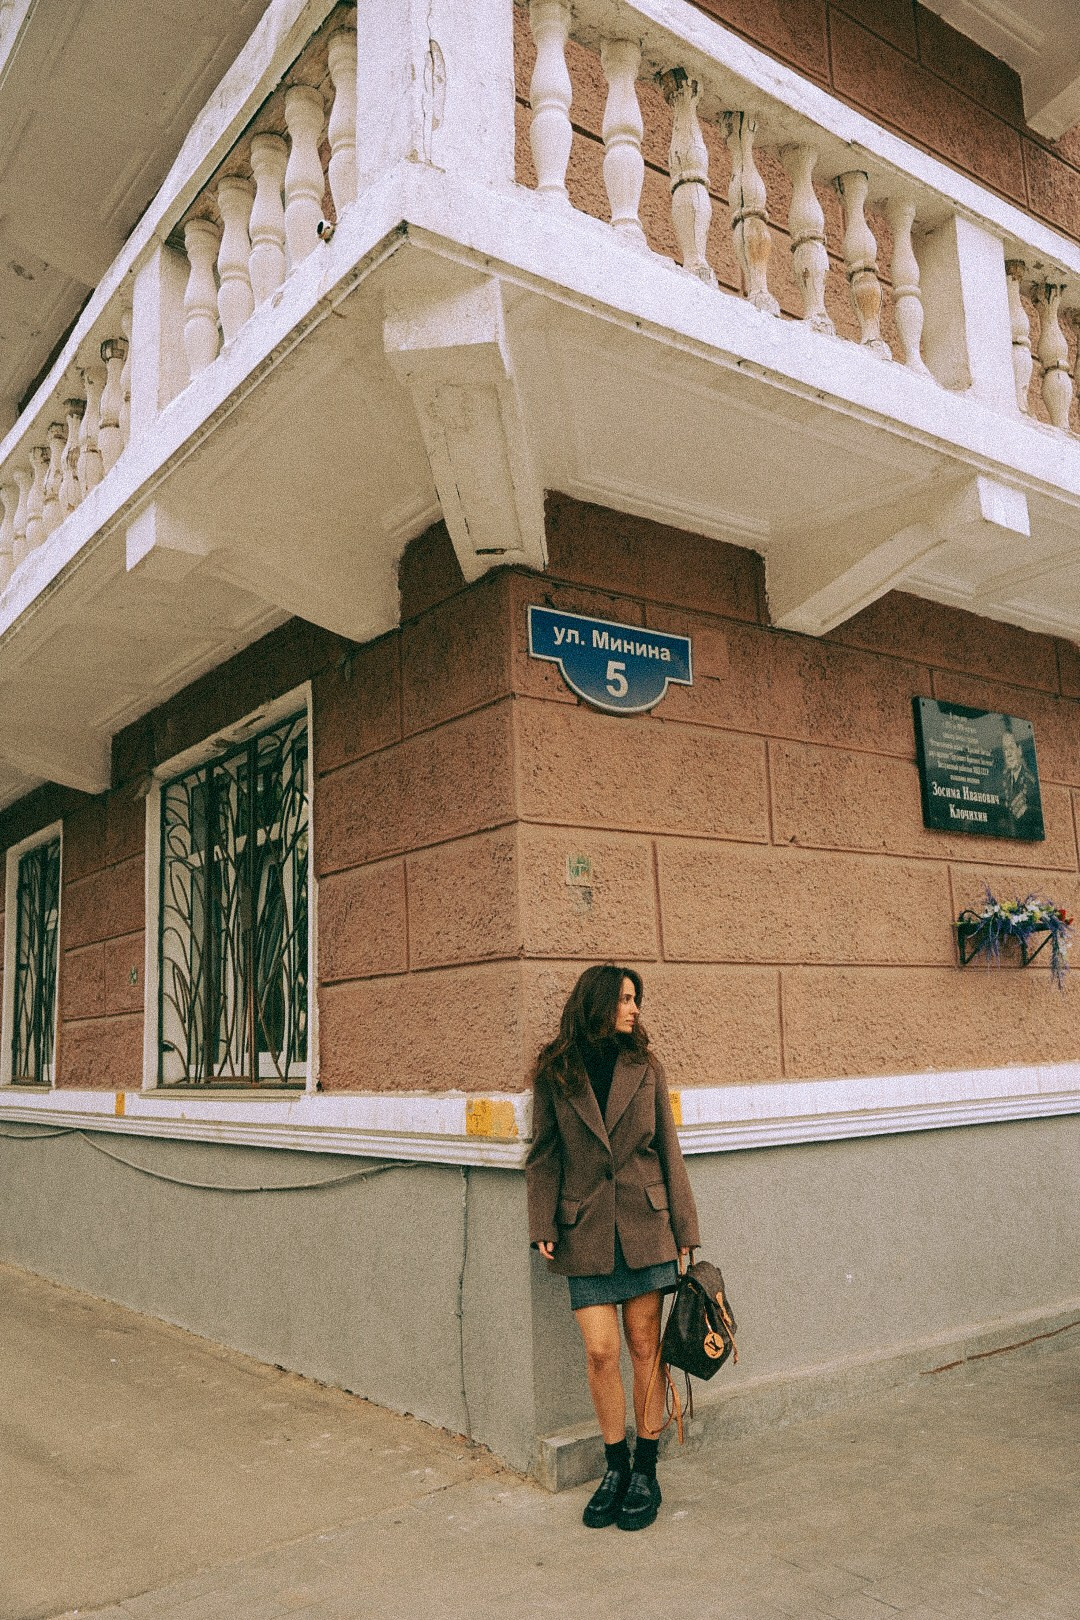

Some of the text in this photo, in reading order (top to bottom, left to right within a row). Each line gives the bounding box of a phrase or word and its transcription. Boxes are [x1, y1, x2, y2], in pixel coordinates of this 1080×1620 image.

[553, 626, 671, 661] ул. Минина
[606, 660, 628, 698] 5
[931, 781, 1000, 805] Зосима Иванович
